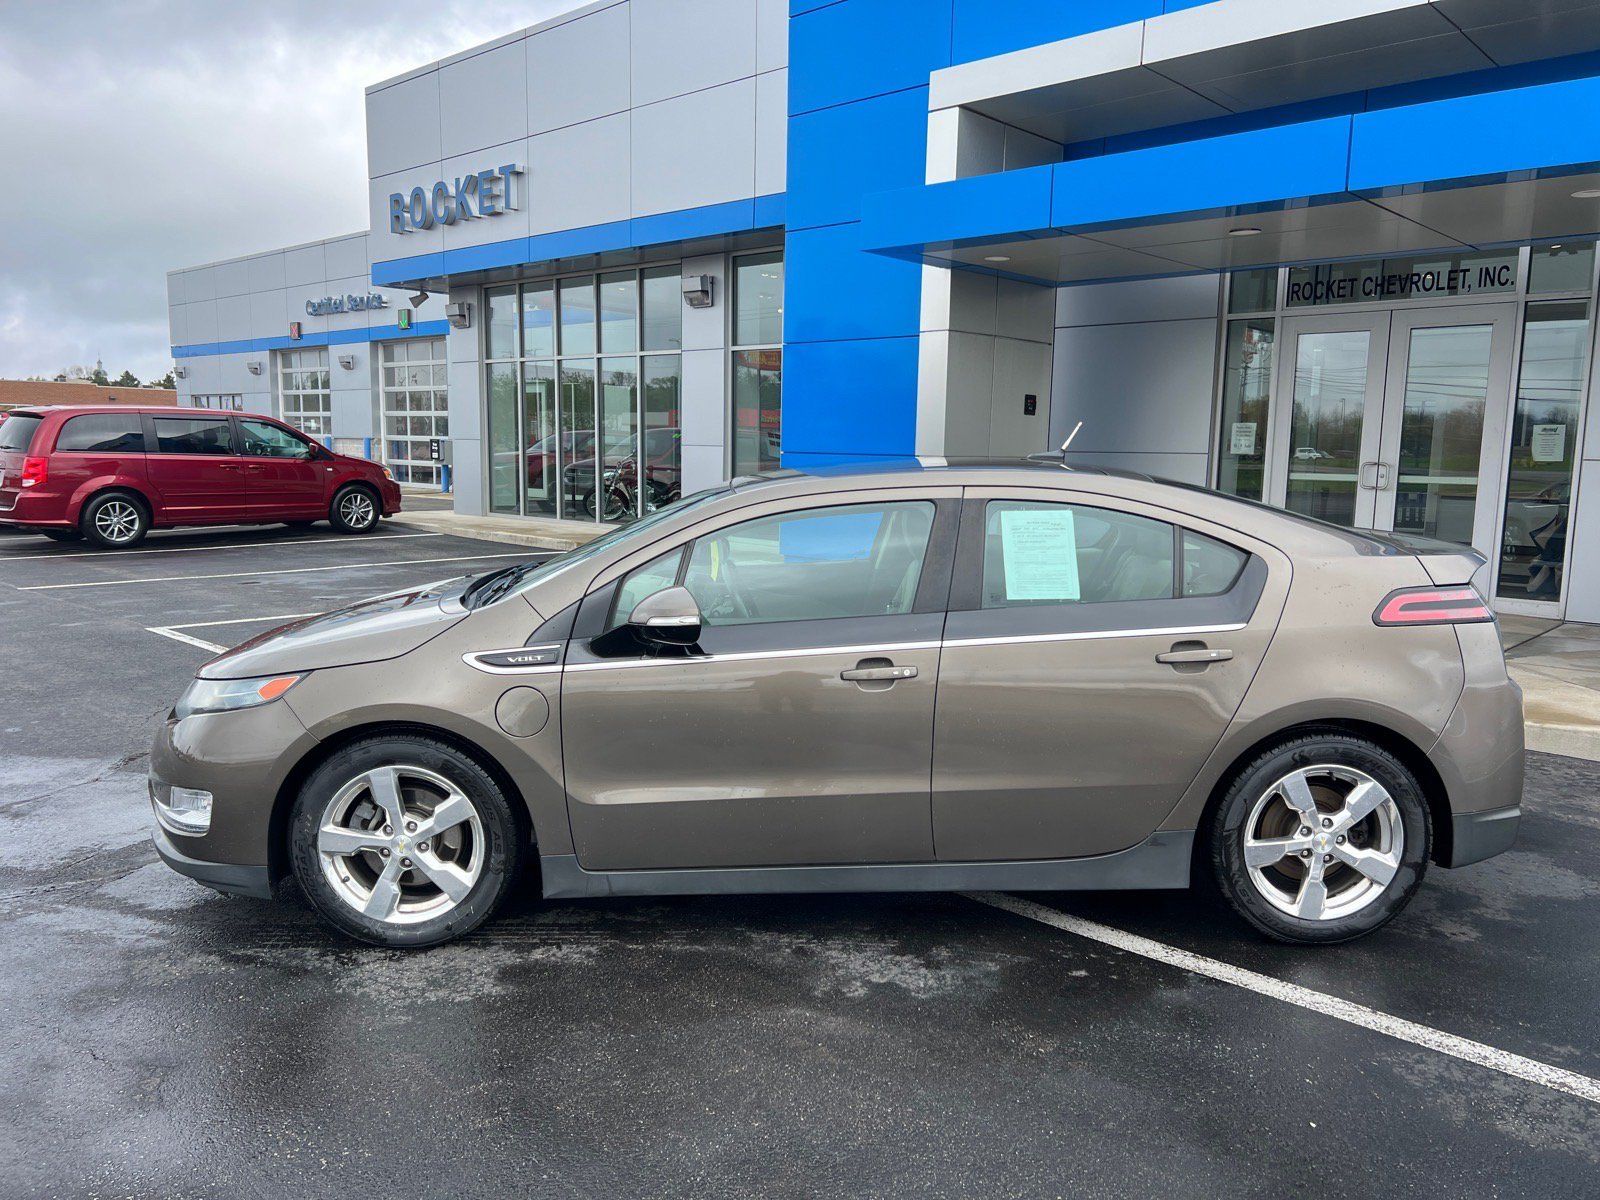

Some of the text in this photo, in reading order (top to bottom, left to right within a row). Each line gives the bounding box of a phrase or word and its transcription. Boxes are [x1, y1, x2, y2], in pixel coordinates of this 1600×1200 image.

[389, 163, 520, 234] ROCKET
[1290, 265, 1515, 301] ROCKET CHEVROLET, INC.
[506, 655, 545, 663] VOLT
